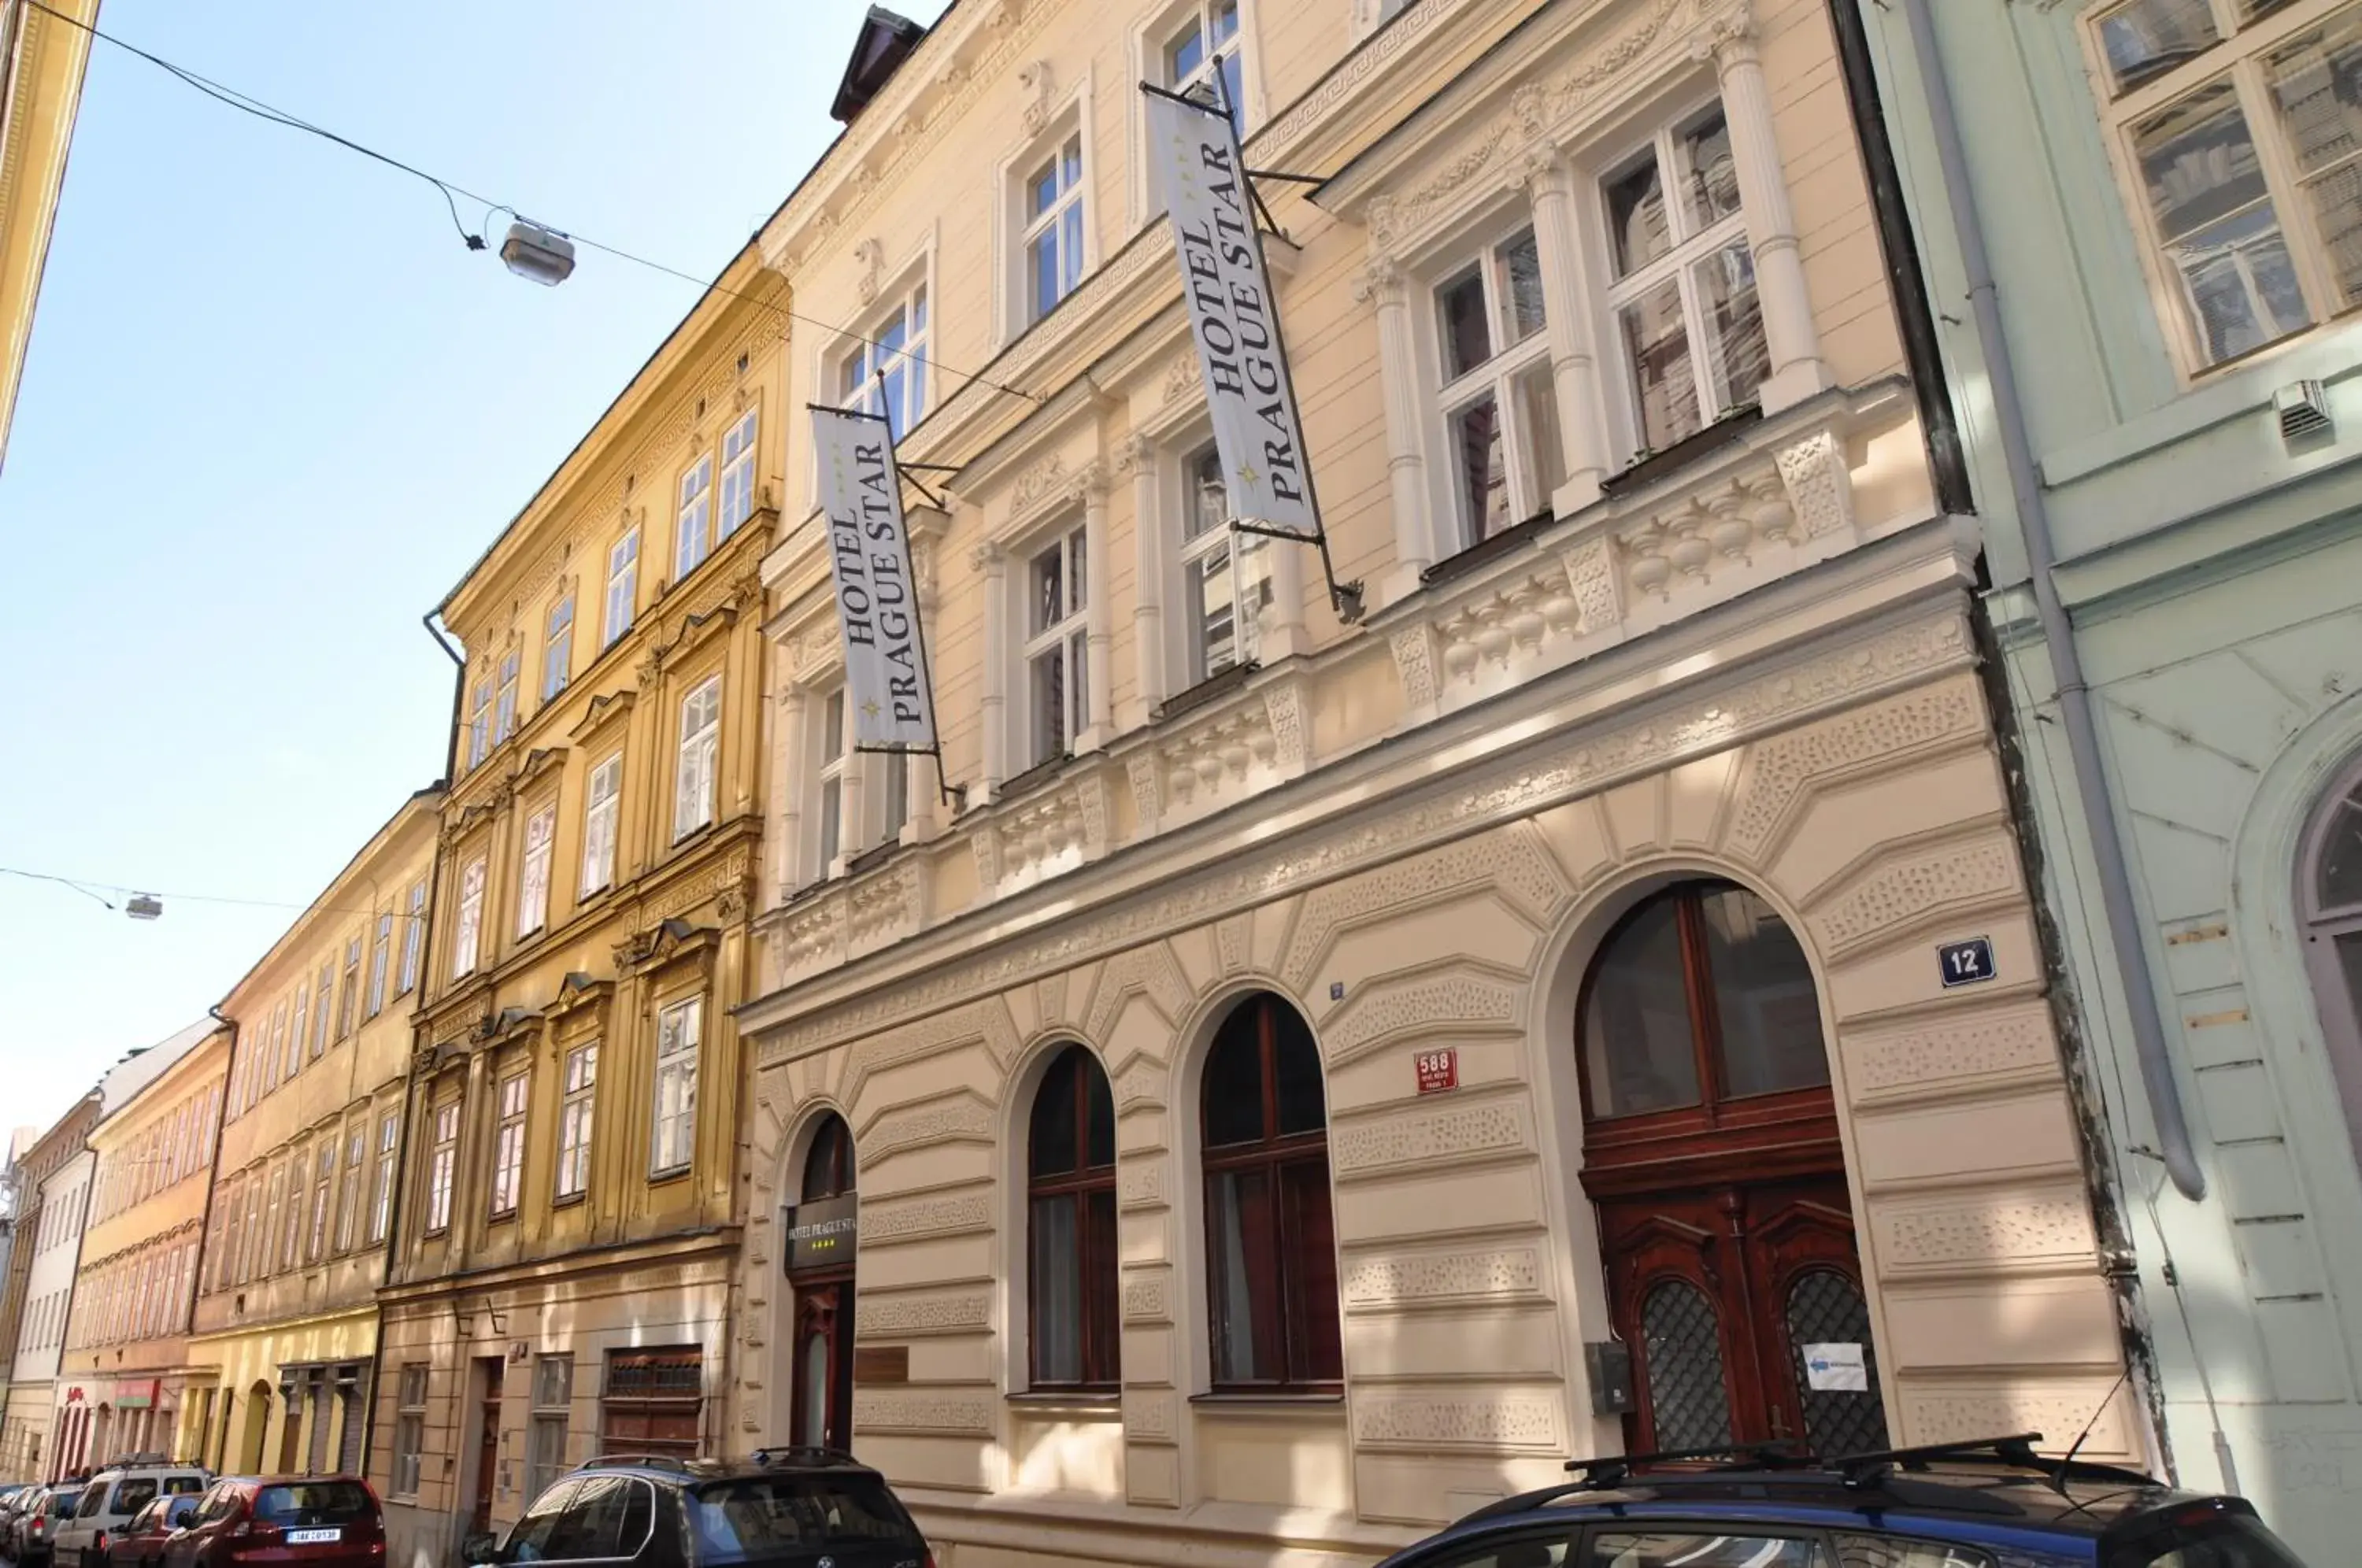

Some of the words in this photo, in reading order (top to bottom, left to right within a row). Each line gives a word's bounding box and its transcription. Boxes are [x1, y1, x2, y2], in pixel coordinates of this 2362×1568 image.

[1201, 142, 1253, 271] STAR
[1183, 221, 1246, 400] HOTEL
[1229, 281, 1304, 505] PRAGUE
[855, 441, 895, 543] STAR
[833, 508, 877, 649] HOTEL
[870, 553, 922, 724] PRAGUE
[1951, 949, 1979, 974] 12
[1420, 1052, 1449, 1073] 588
